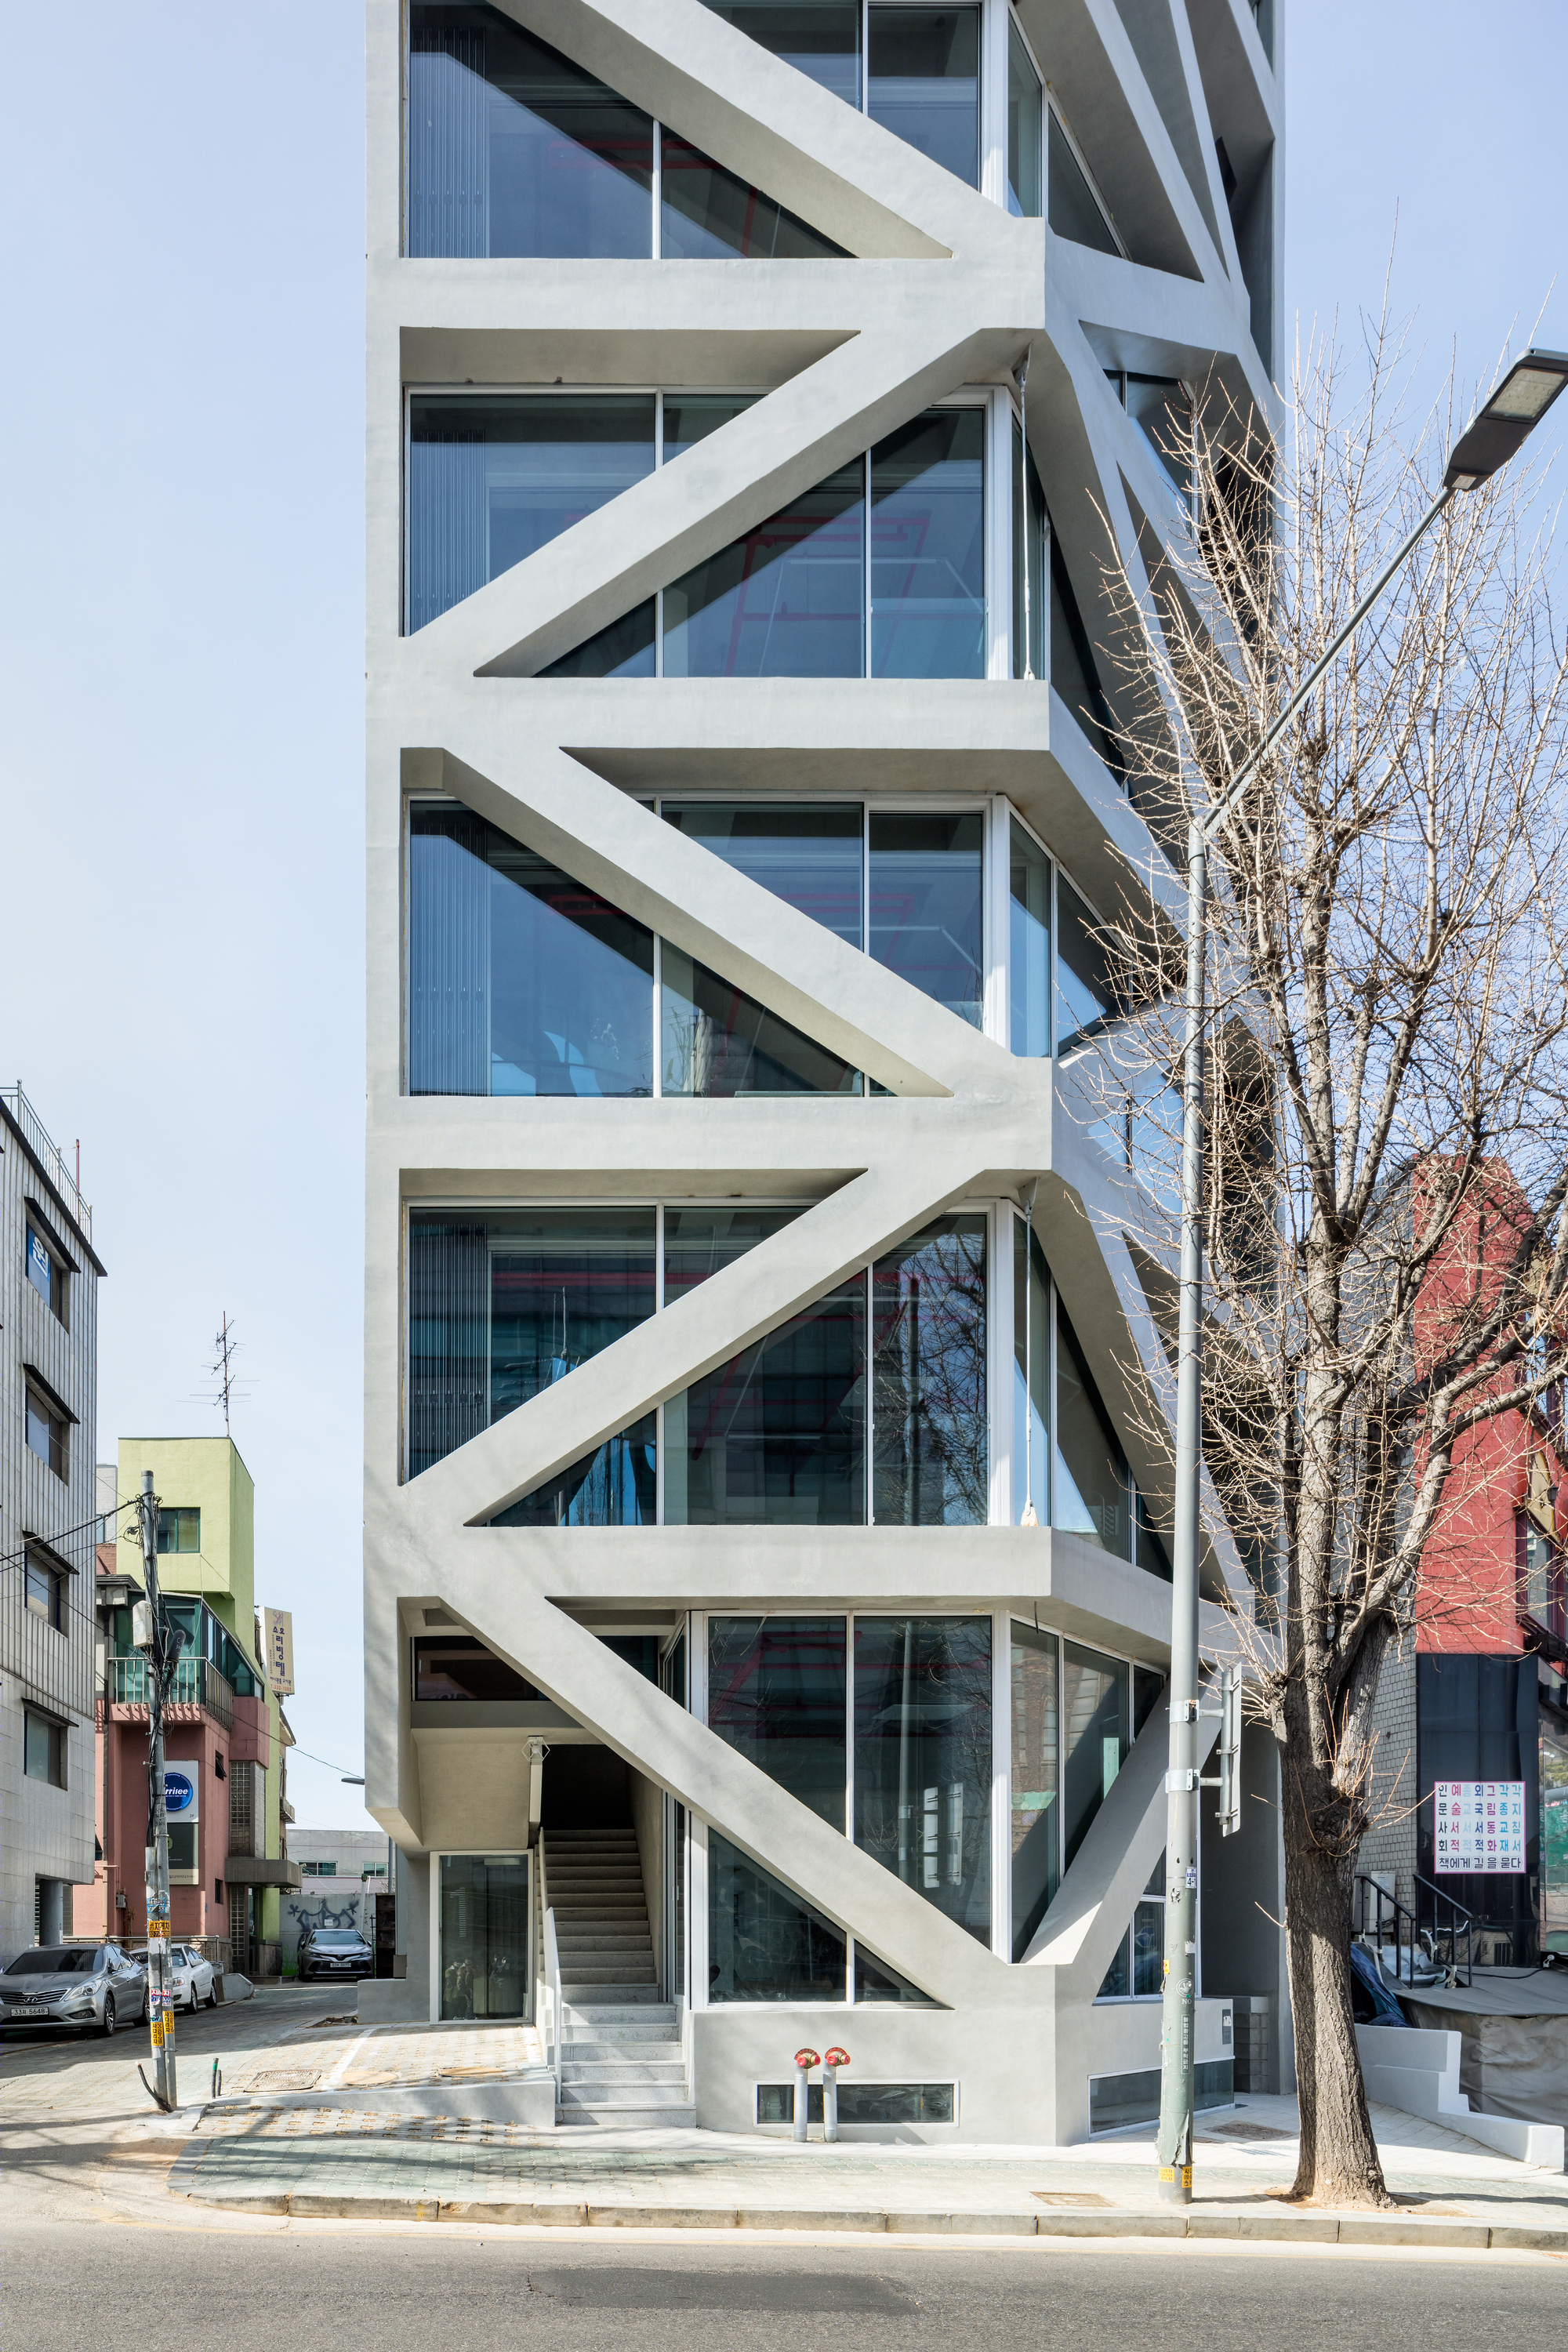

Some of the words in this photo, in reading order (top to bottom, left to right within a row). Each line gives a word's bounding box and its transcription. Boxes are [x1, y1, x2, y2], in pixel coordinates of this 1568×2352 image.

[273, 1626, 285, 1635] 소호
[275, 1635, 285, 1676] 리빙텔
[1438, 1784, 1448, 1852] 인문사회
[1450, 1784, 1461, 1852] 예술서적
[1462, 1784, 1472, 1852] 종교서적
[1475, 1784, 1483, 1852] 외국서적
[1486, 1784, 1497, 1852] 그림동화
[1499, 1784, 1509, 1852] 각종교재
[1512, 1784, 1521, 1852] 각지침서
[1439, 1857, 1471, 1869] 책에게
[1500, 1857, 1522, 1869] 묻다
